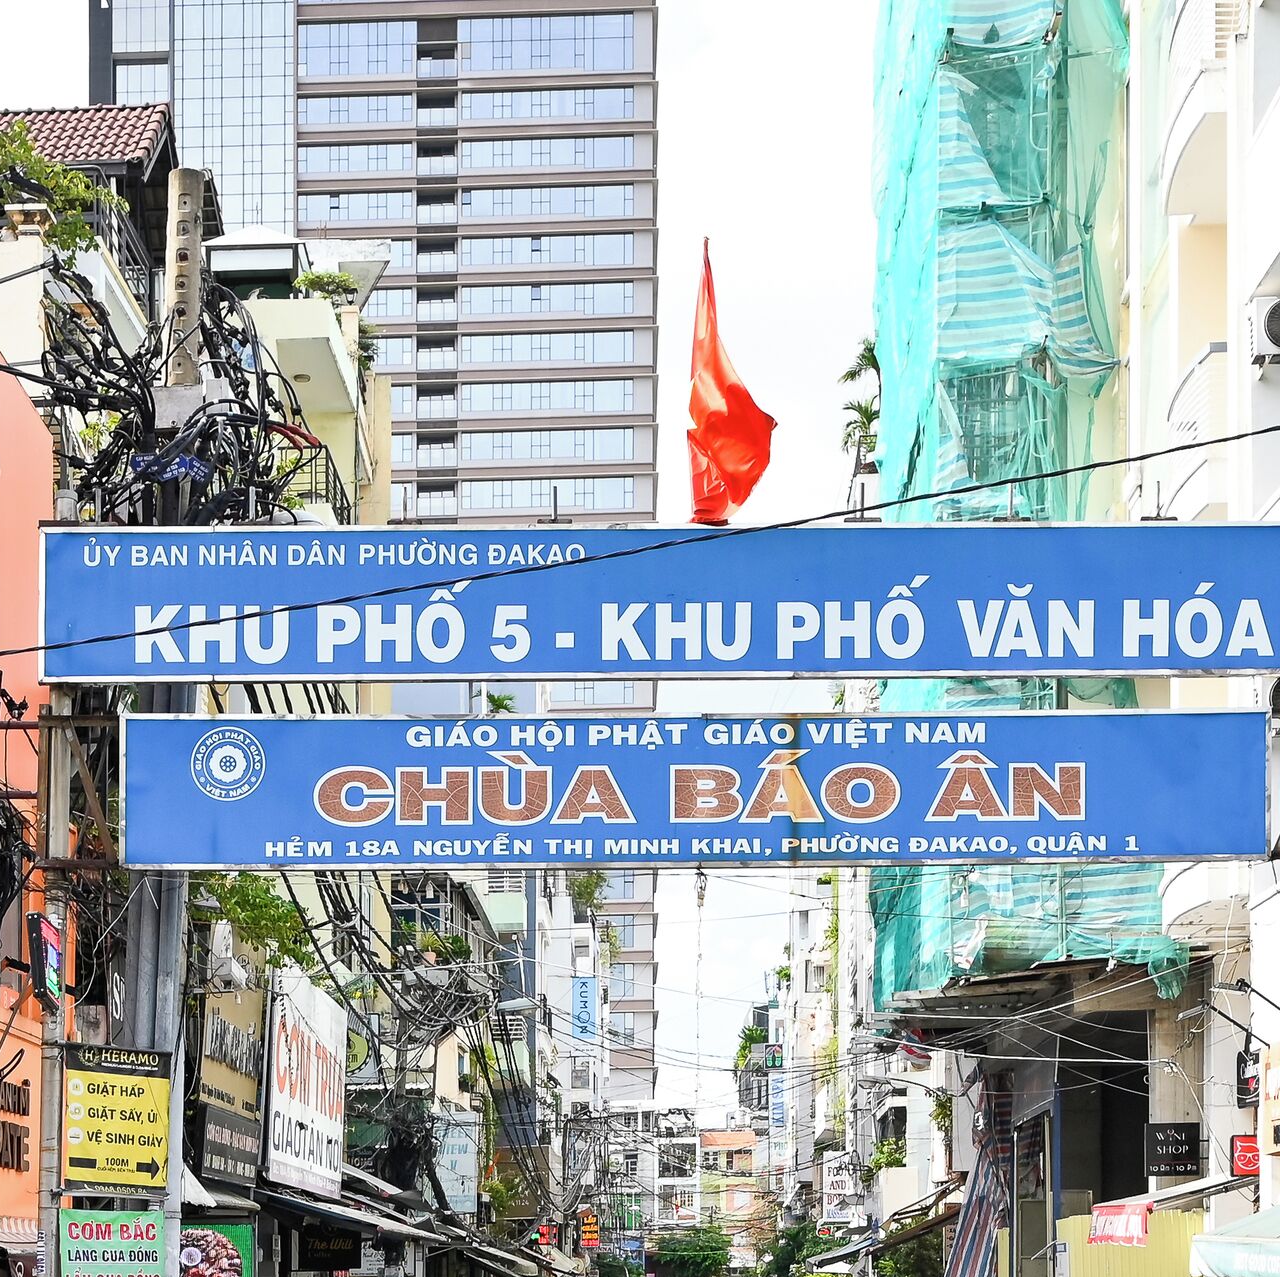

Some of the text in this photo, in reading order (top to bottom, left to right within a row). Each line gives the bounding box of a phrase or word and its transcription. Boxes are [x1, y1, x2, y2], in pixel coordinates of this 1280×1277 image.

[82, 537, 587, 567] ỦY BAN NHÂN DÂN PHƯỜNG ĐAKAO
[133, 603, 290, 665] KHU
[316, 581, 473, 664] PHỐ
[490, 605, 532, 664] 5
[600, 601, 752, 662] KHU
[776, 575, 931, 661] PHỐ
[956, 583, 1095, 660] VĂN
[1122, 582, 1275, 658] HÓA
[405, 717, 987, 754] GIÁO HỘI PHẬT GIÁO VIỆT NAM
[229, 783, 251, 797] NAM
[312, 748, 1087, 828] CHÙA BÁO ÂN
[264, 830, 1140, 858] HẺM 18A NGUYỄN THỊ MINH KHAI, PHƯỜNG ĐAKAO, QUẬN 1
[578, 981, 590, 1035] KUMON
[101, 1050, 159, 1066] HERAMO
[87, 1081, 145, 1098] GIẶT HẤP
[87, 1106, 117, 1122] GIẶT
[86, 1128, 164, 1148] VỆ SINH GIÀY
[1156, 1144, 1189, 1155] SHOP
[105, 1157, 129, 1167] 100M
[829, 1179, 847, 1191] AND
[67, 1217, 158, 1241] CƠM BẮC
[67, 1247, 99, 1263] LÀNG
[102, 1249, 124, 1263] CUA
